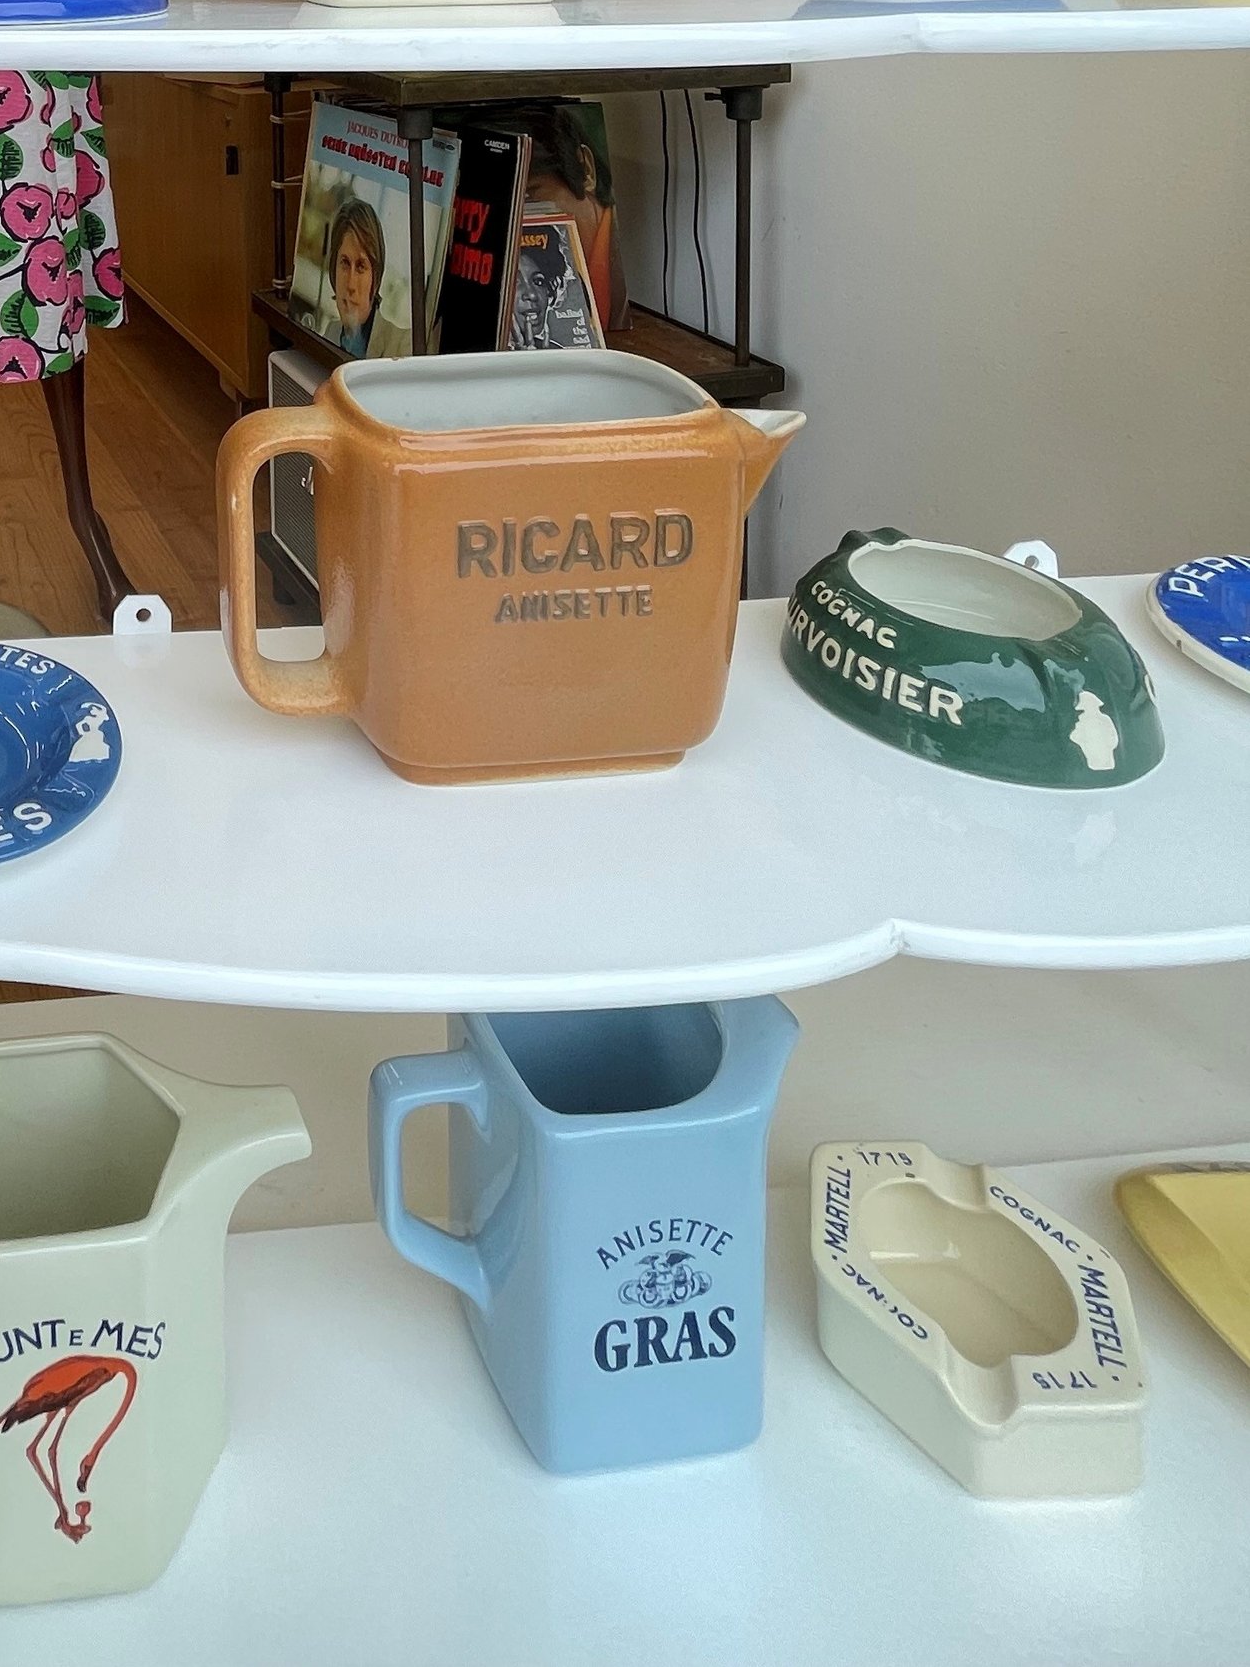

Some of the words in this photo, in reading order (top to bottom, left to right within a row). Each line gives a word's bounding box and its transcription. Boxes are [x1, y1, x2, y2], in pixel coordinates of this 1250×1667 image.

[454, 196, 491, 244] rry
[449, 243, 494, 286] omo
[456, 508, 694, 579] RICARD
[495, 584, 654, 624] ANISETTE
[811, 580, 898, 650] COGNAC
[824, 1165, 851, 1254] MARTELL
[989, 1185, 1081, 1254] COGNAC
[596, 1218, 734, 1270] ANISETTE
[90, 1319, 166, 1360] MES
[594, 1306, 737, 1373] GRAS
[1077, 1263, 1128, 1369] MARTELL
